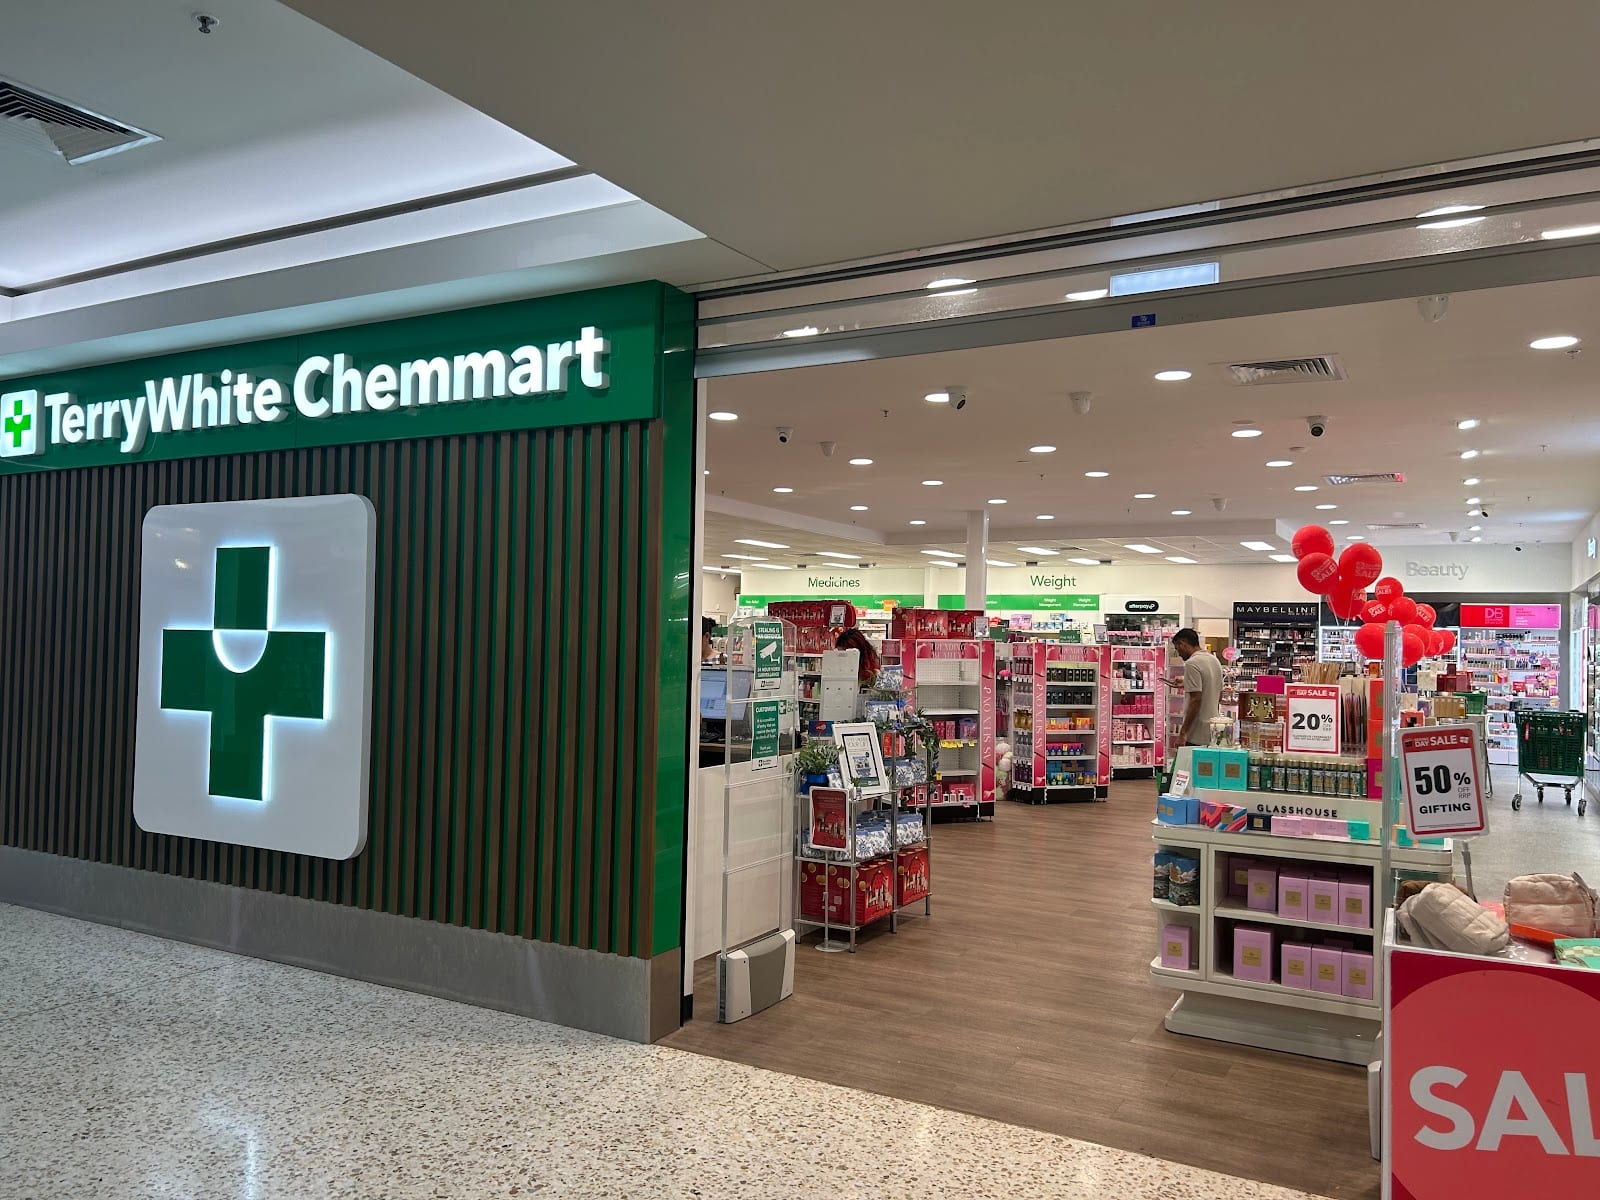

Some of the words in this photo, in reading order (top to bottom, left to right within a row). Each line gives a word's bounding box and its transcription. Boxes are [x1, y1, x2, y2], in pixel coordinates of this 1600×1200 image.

[44, 368, 284, 453] TerryWhite
[293, 326, 607, 418] Chemmart
[1405, 561, 1469, 581] Beauty
[808, 576, 861, 588] Medicines
[1030, 574, 1077, 590] Weight
[1236, 606, 1317, 614] MAYBELLINE
[983, 696, 991, 713] ON
[1430, 735, 1458, 746] SALE
[1257, 804, 1338, 817] GLASSHOUSE
[1419, 803, 1472, 815] GIFTING
